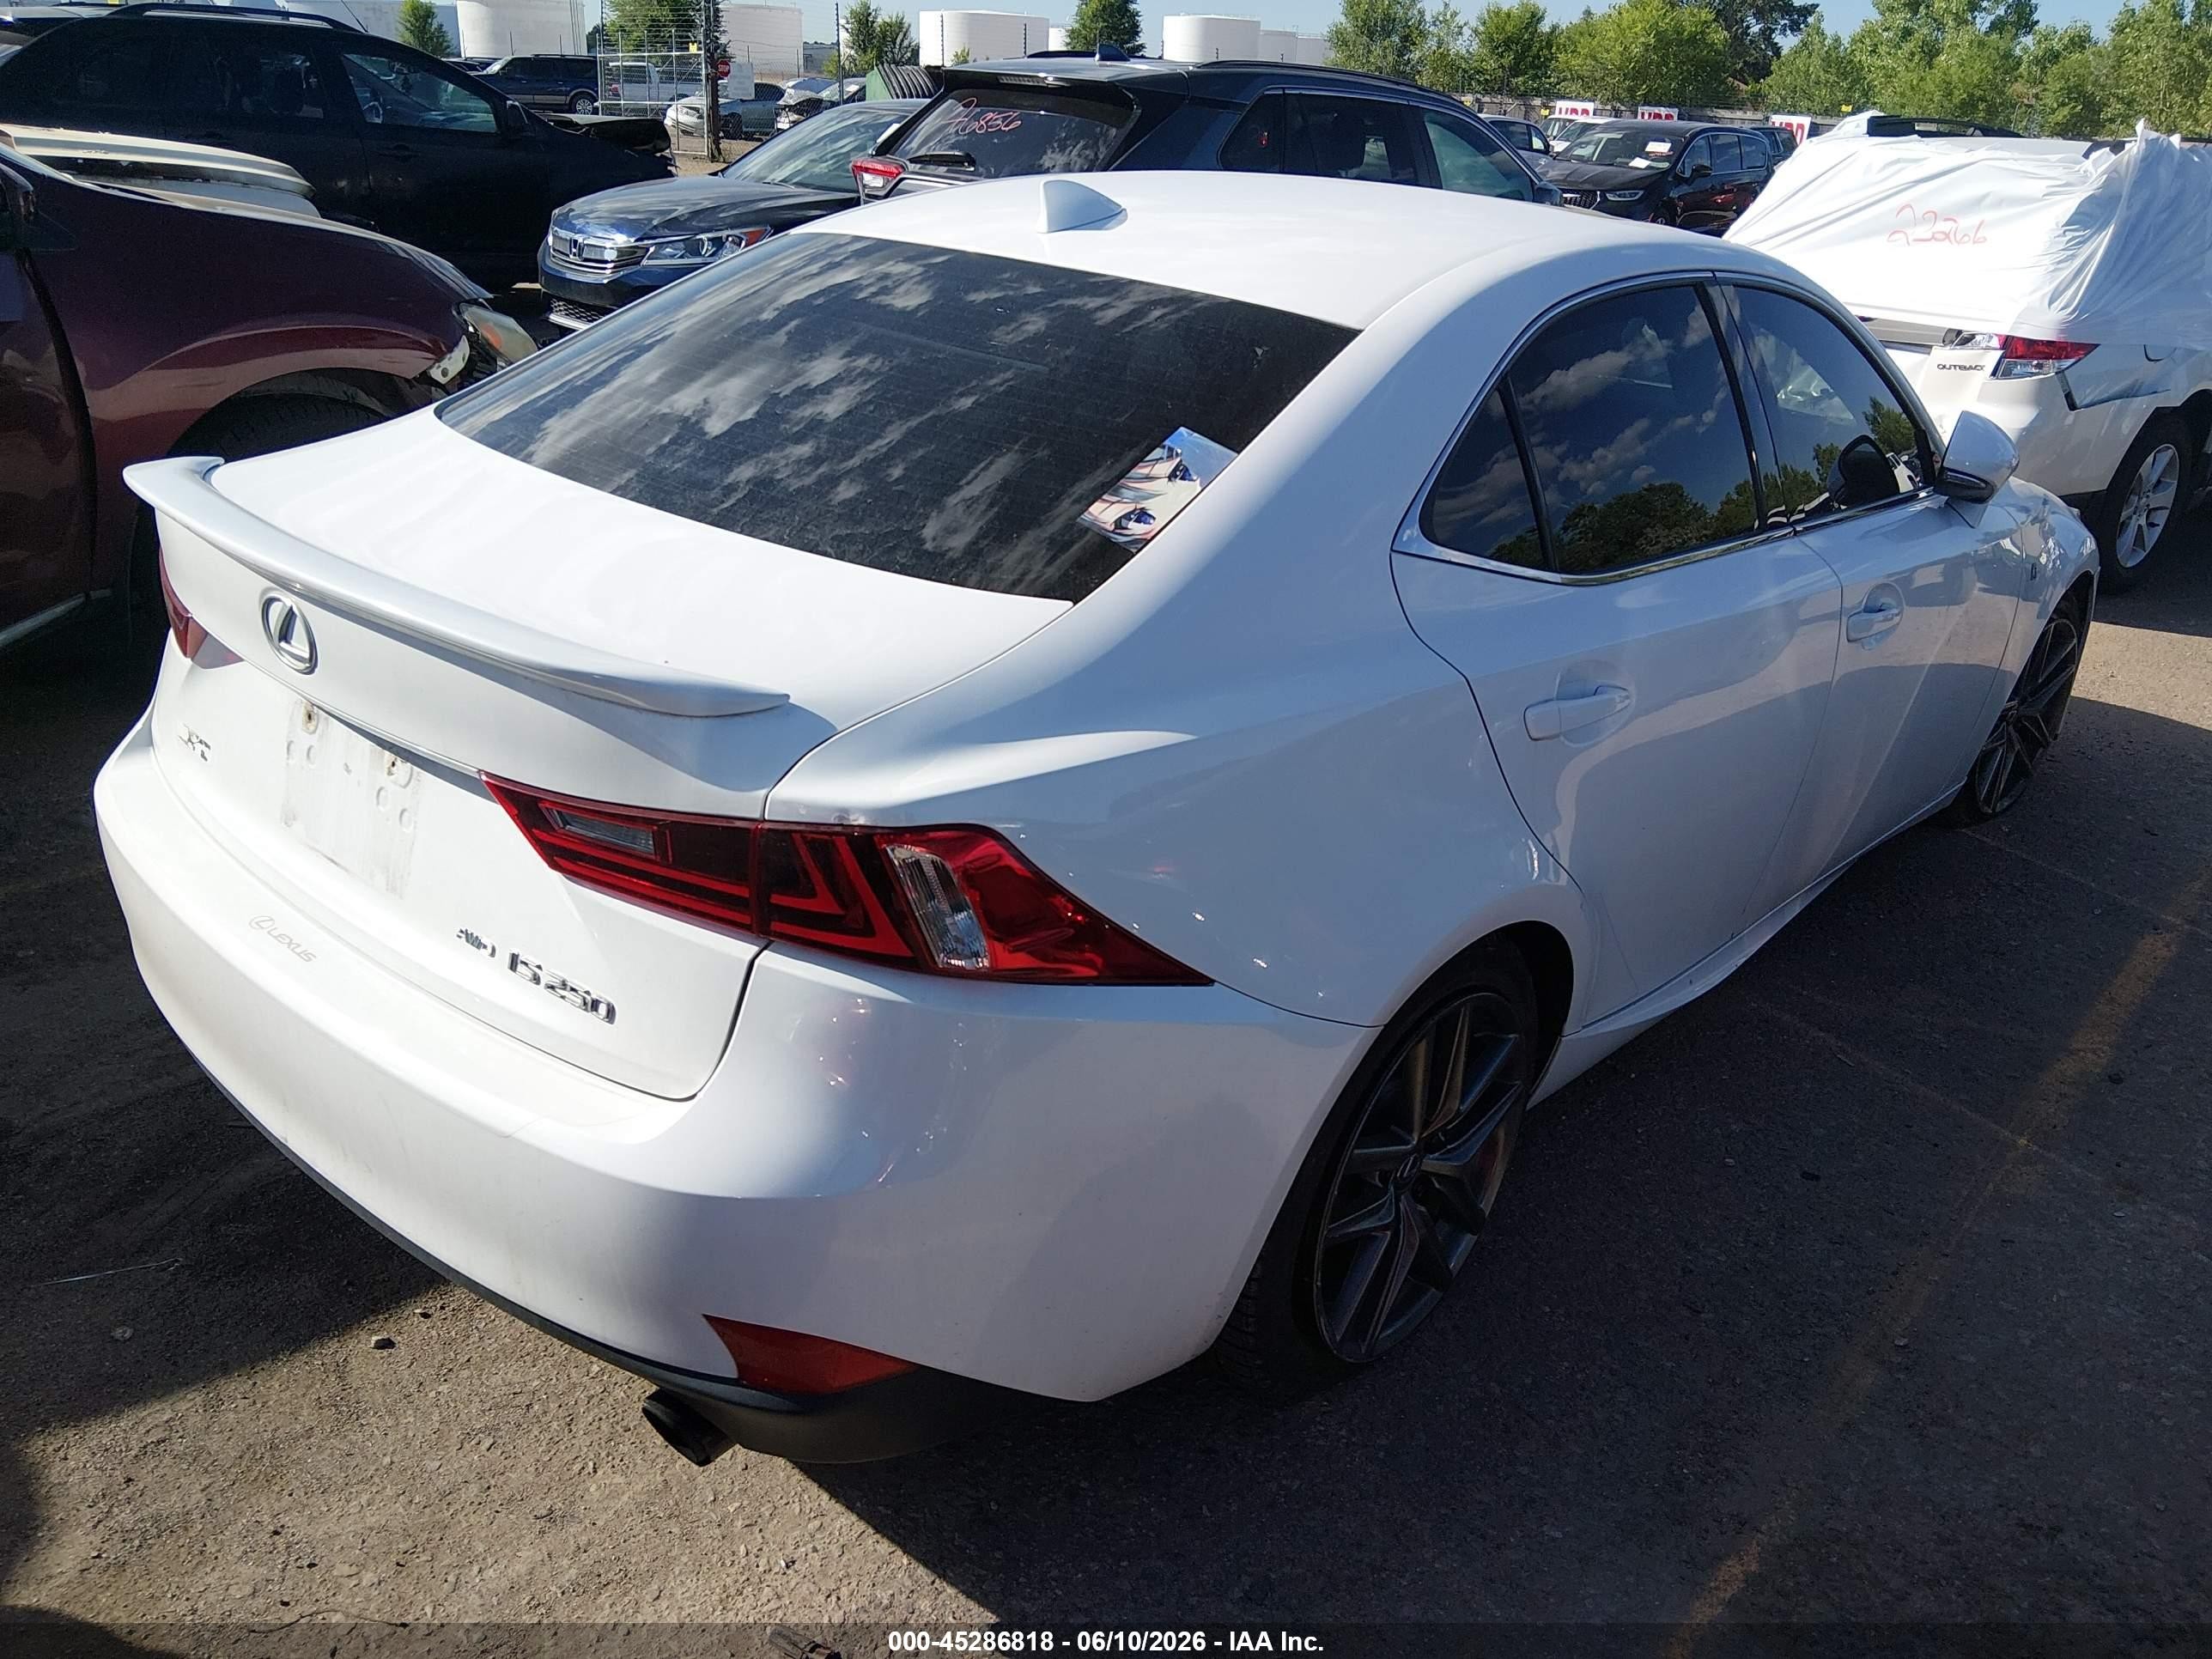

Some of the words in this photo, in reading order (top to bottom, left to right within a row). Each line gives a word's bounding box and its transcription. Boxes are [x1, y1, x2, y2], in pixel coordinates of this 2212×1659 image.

[1936, 363, 1986, 372] OUTBACK
[267, 927, 317, 963] LEXUS
[544, 968, 617, 1025] 250
